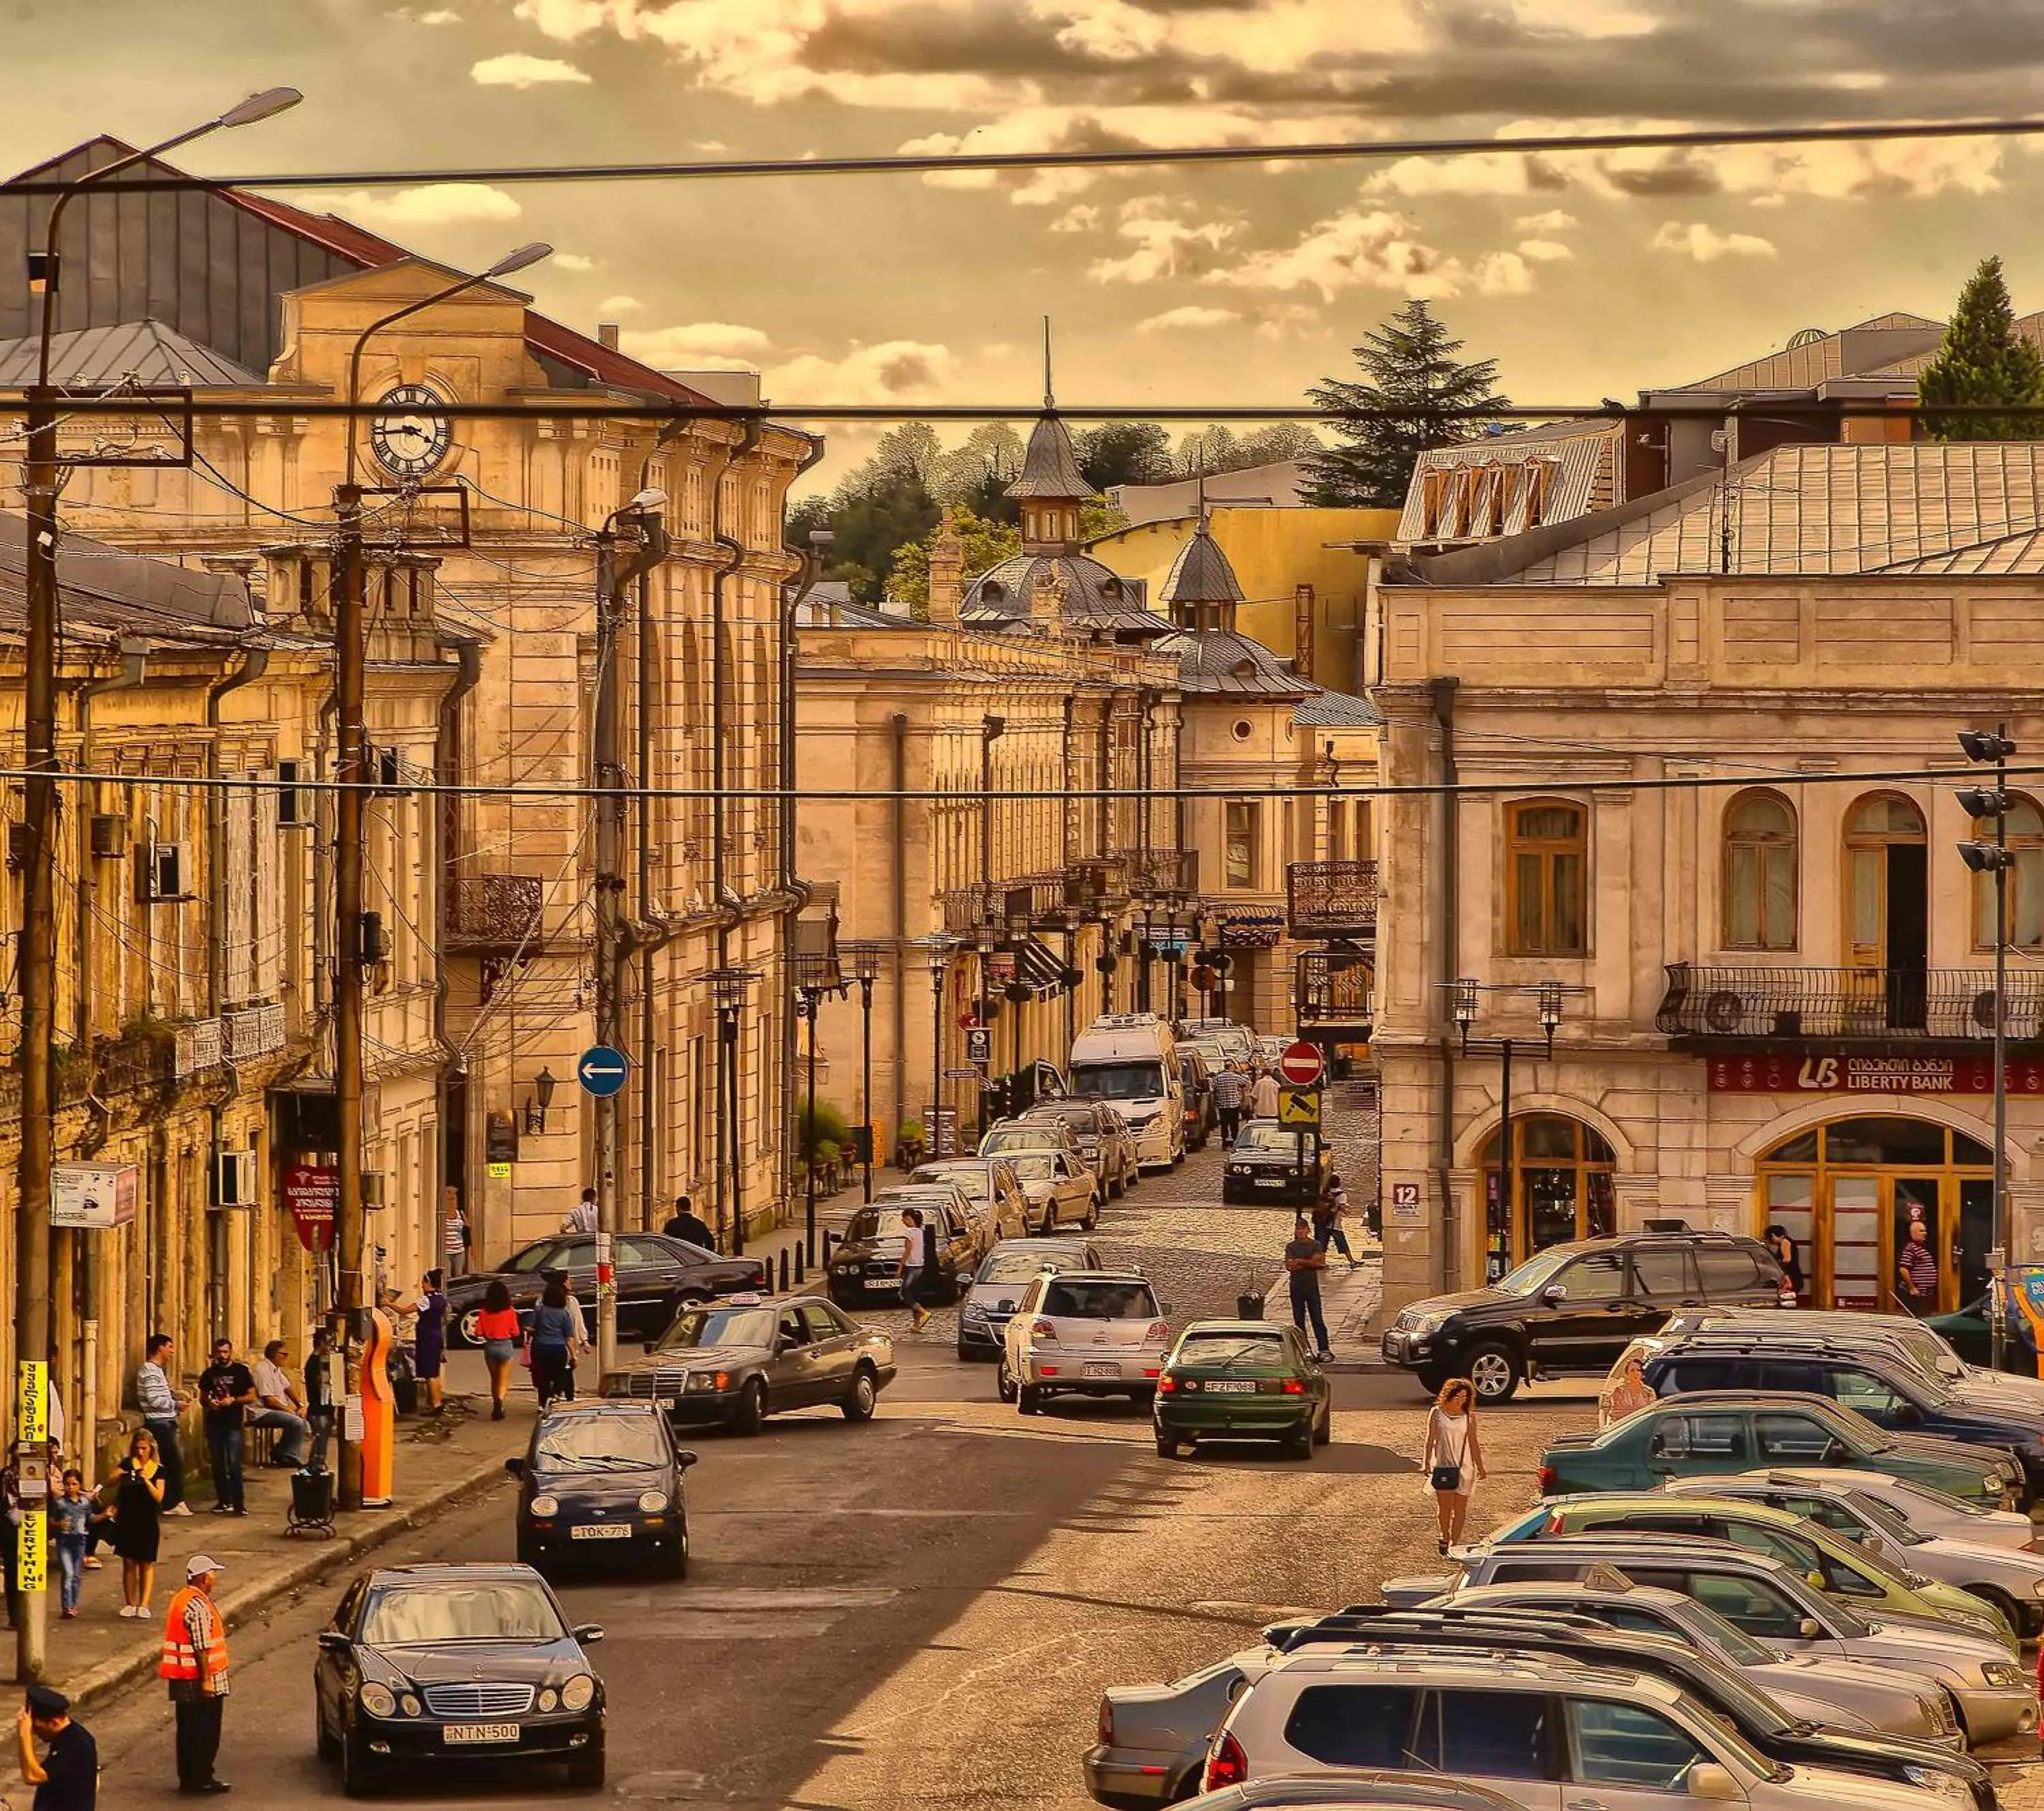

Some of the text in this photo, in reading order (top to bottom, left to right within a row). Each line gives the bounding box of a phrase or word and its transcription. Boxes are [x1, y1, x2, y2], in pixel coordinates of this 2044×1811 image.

[1848, 1058, 1953, 1073] ლიბერთი ბანკი
[1847, 1075, 1953, 1090] LIBERTY BANK
[1396, 1187, 1416, 1204] 12
[24, 1513, 36, 1590] EVERYTHING
[453, 1724, 518, 1739] NTN-500
